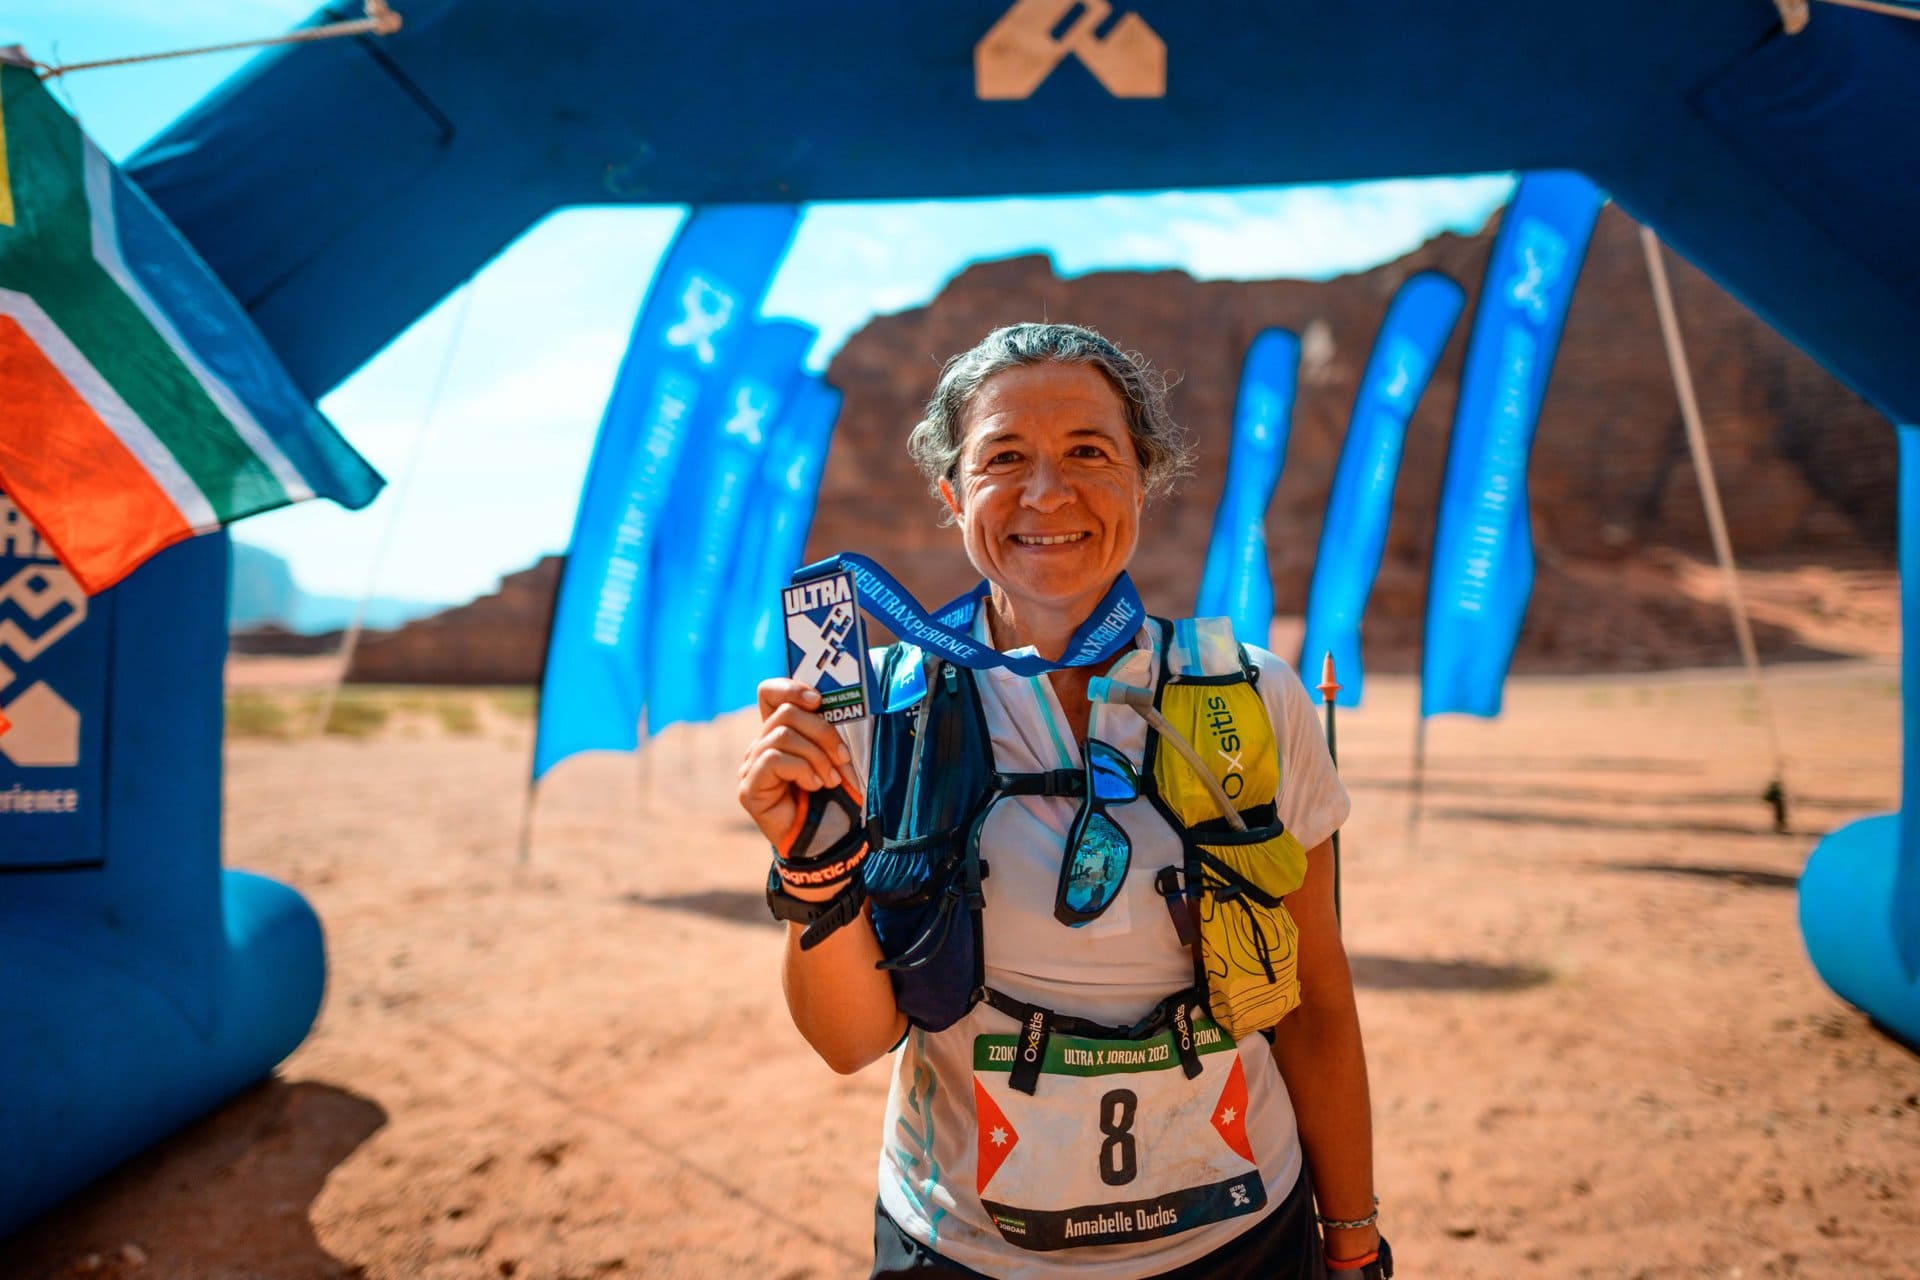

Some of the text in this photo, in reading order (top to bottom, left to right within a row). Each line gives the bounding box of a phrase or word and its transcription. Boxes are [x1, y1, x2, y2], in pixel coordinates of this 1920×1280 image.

[784, 575, 852, 616] ULTRA
[823, 704, 862, 722] RDAN
[779, 863, 845, 884] agnetic
[1064, 1044, 1169, 1066] ULTRA X JORDAN 2023
[1099, 1088, 1138, 1186] 8
[1000, 1223, 1026, 1236] JORDAN
[1064, 1205, 1178, 1239] Annabelle Duclos
